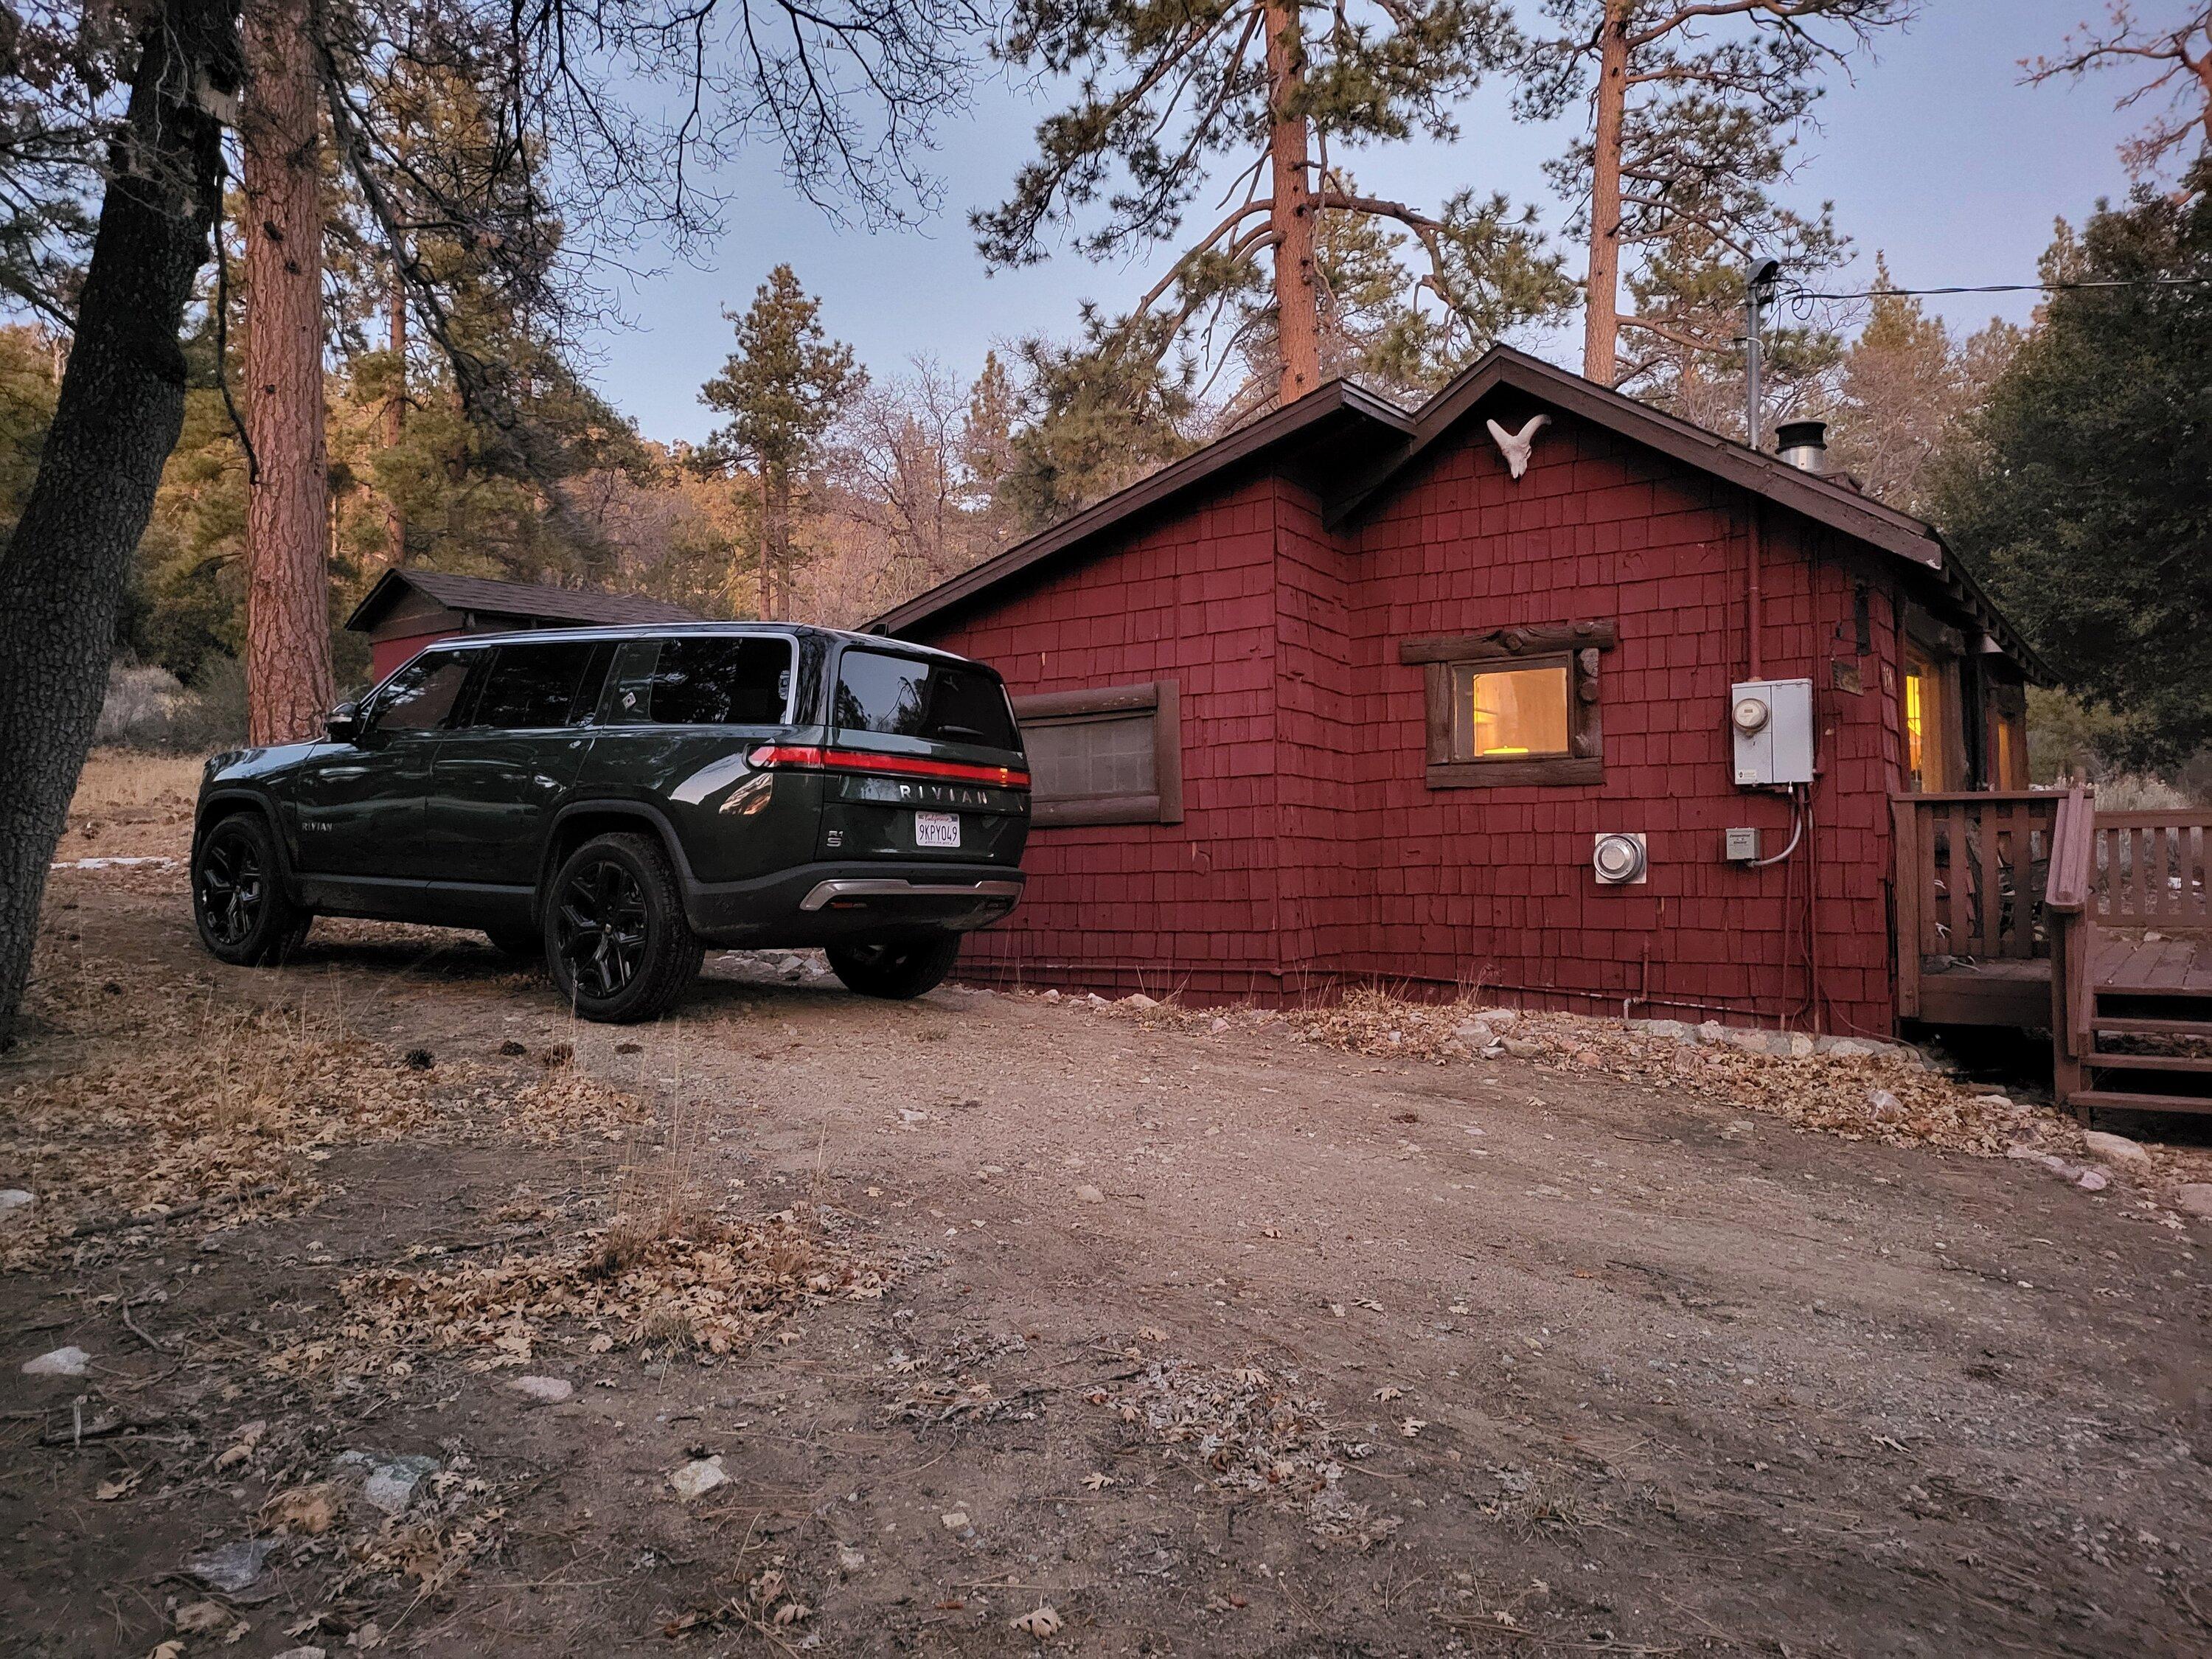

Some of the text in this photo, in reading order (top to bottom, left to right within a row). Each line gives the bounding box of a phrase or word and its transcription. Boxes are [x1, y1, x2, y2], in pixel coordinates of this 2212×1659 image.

[899, 785, 987, 804] RIVIAN
[302, 822, 333, 832] RIVIAN
[919, 824, 957, 841] 9KPY049
